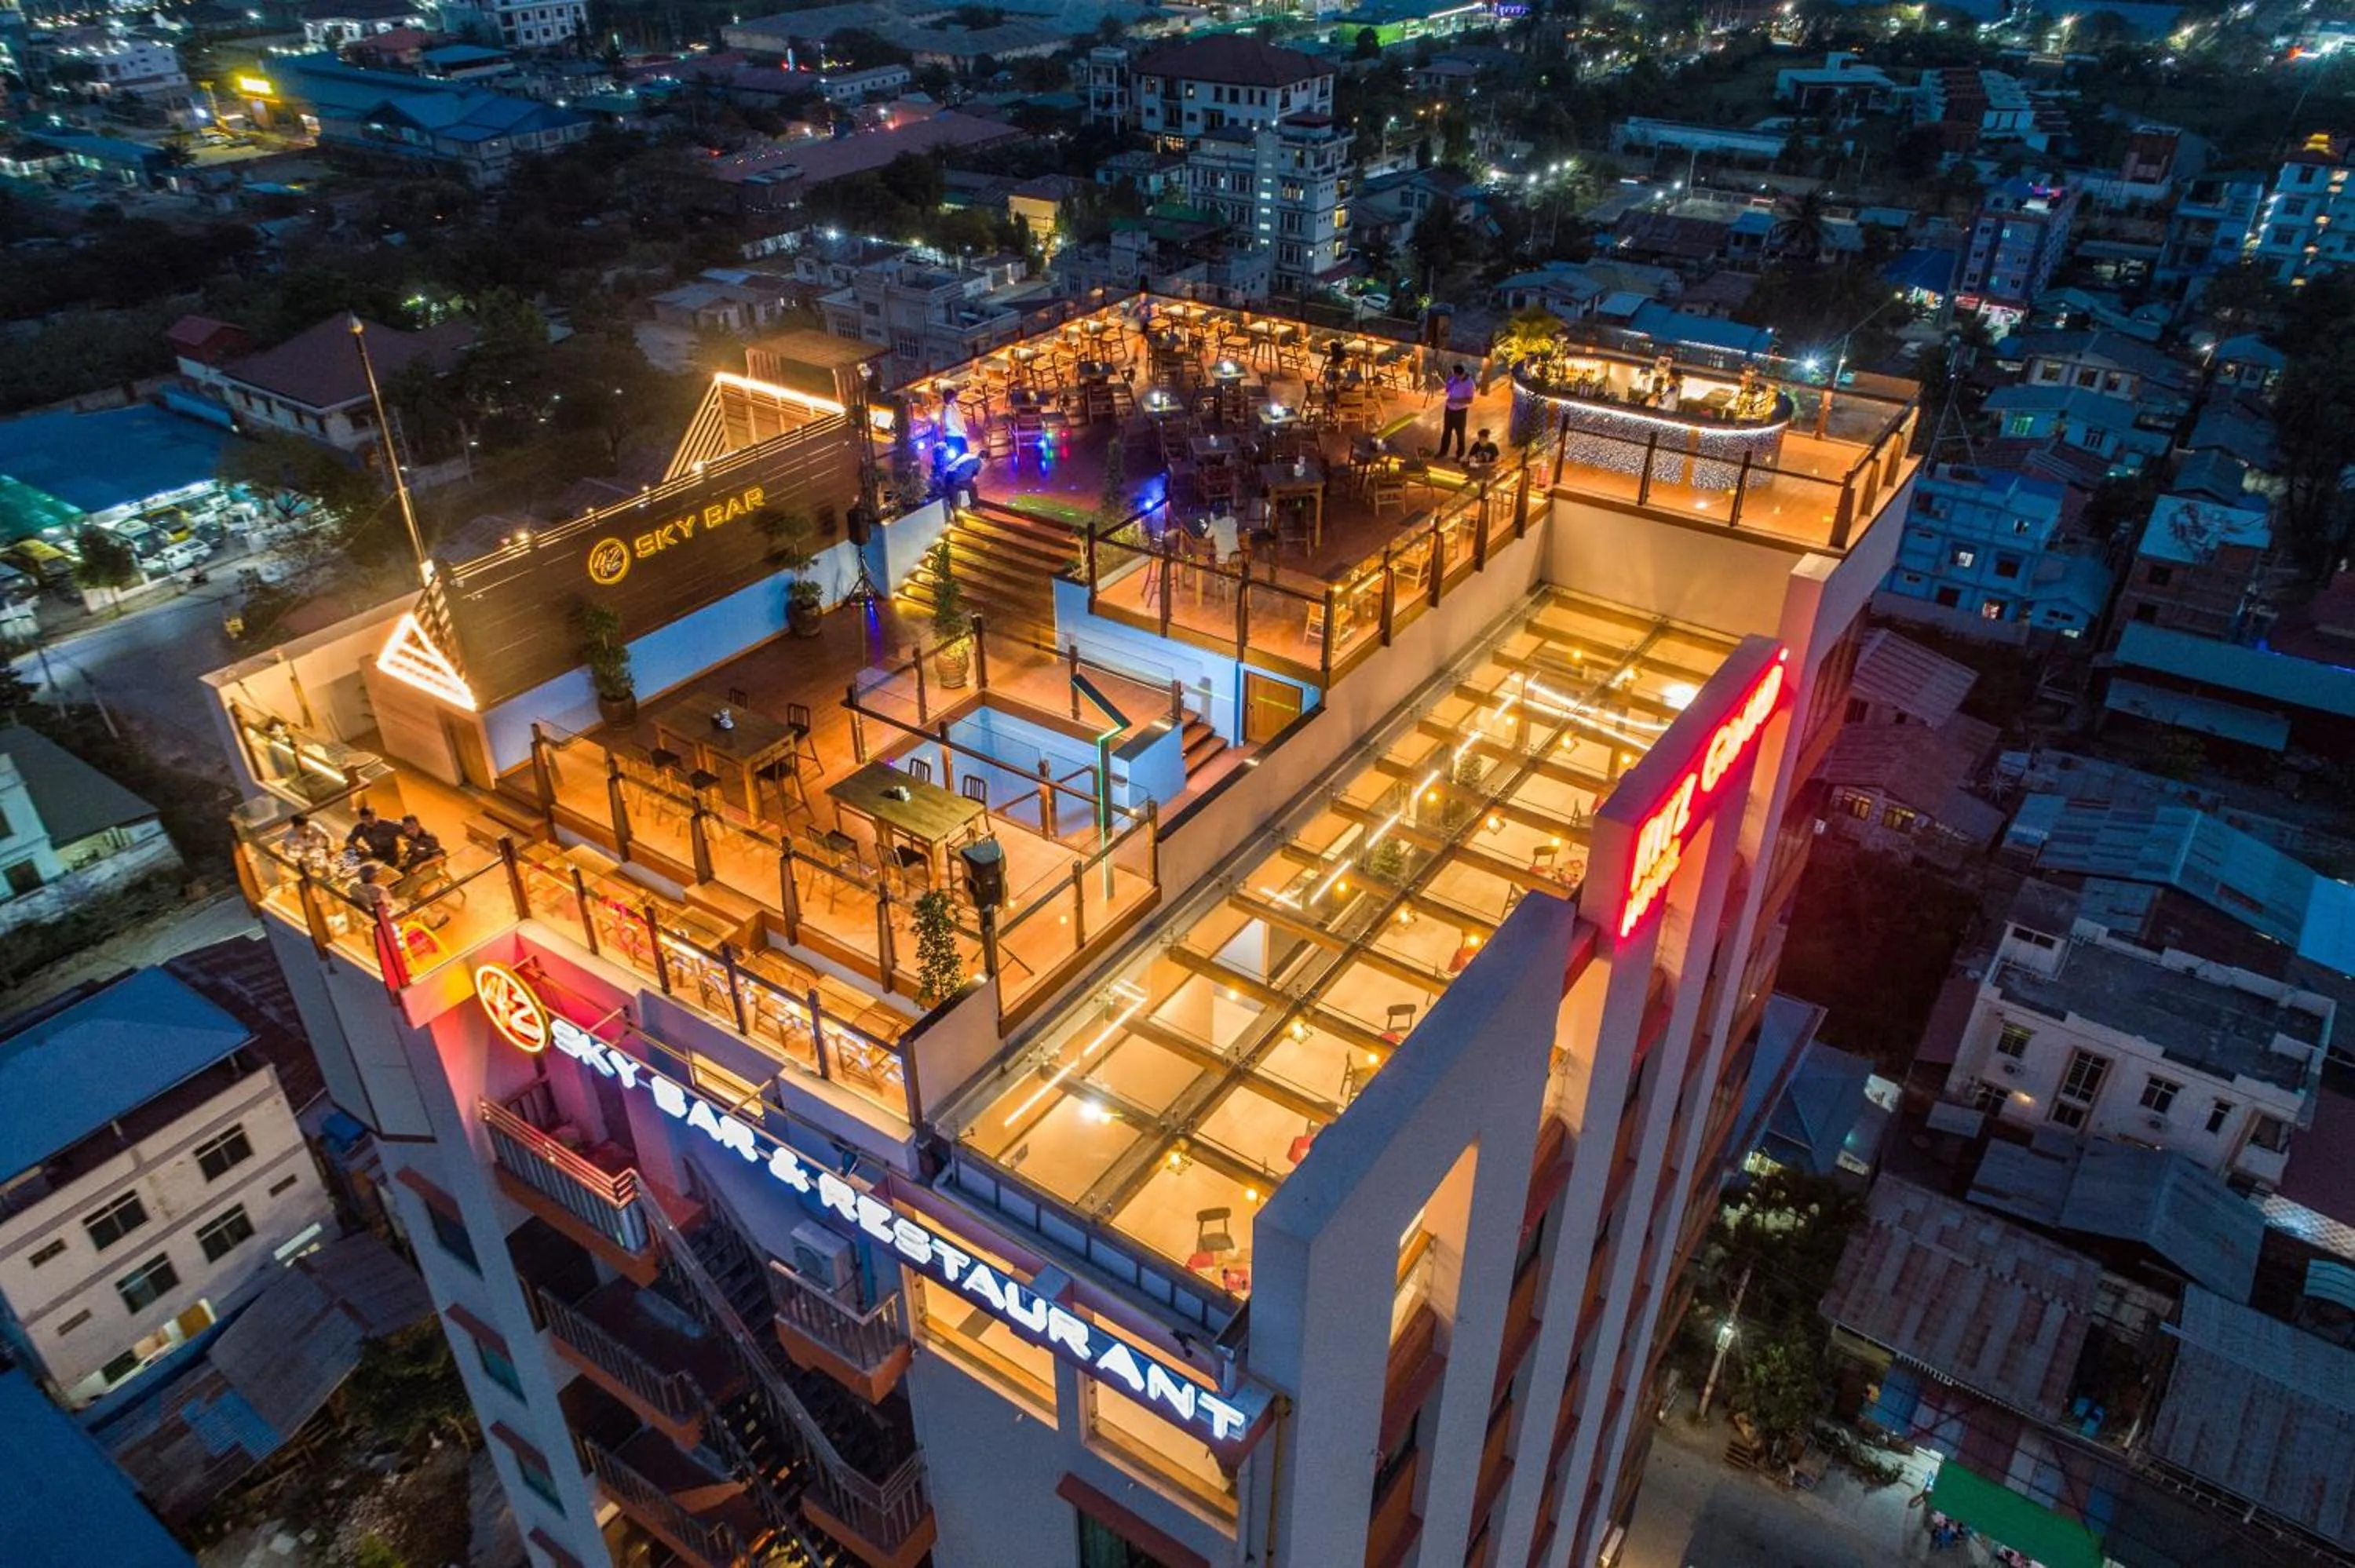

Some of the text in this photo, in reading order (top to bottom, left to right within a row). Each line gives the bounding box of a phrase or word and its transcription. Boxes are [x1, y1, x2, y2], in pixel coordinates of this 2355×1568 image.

[633, 515, 696, 558] SKY
[703, 487, 766, 530] BAR
[550, 1019, 641, 1089] SKY
[650, 1075, 759, 1163] BAR
[819, 1172, 1245, 1441] RESTAURANT
